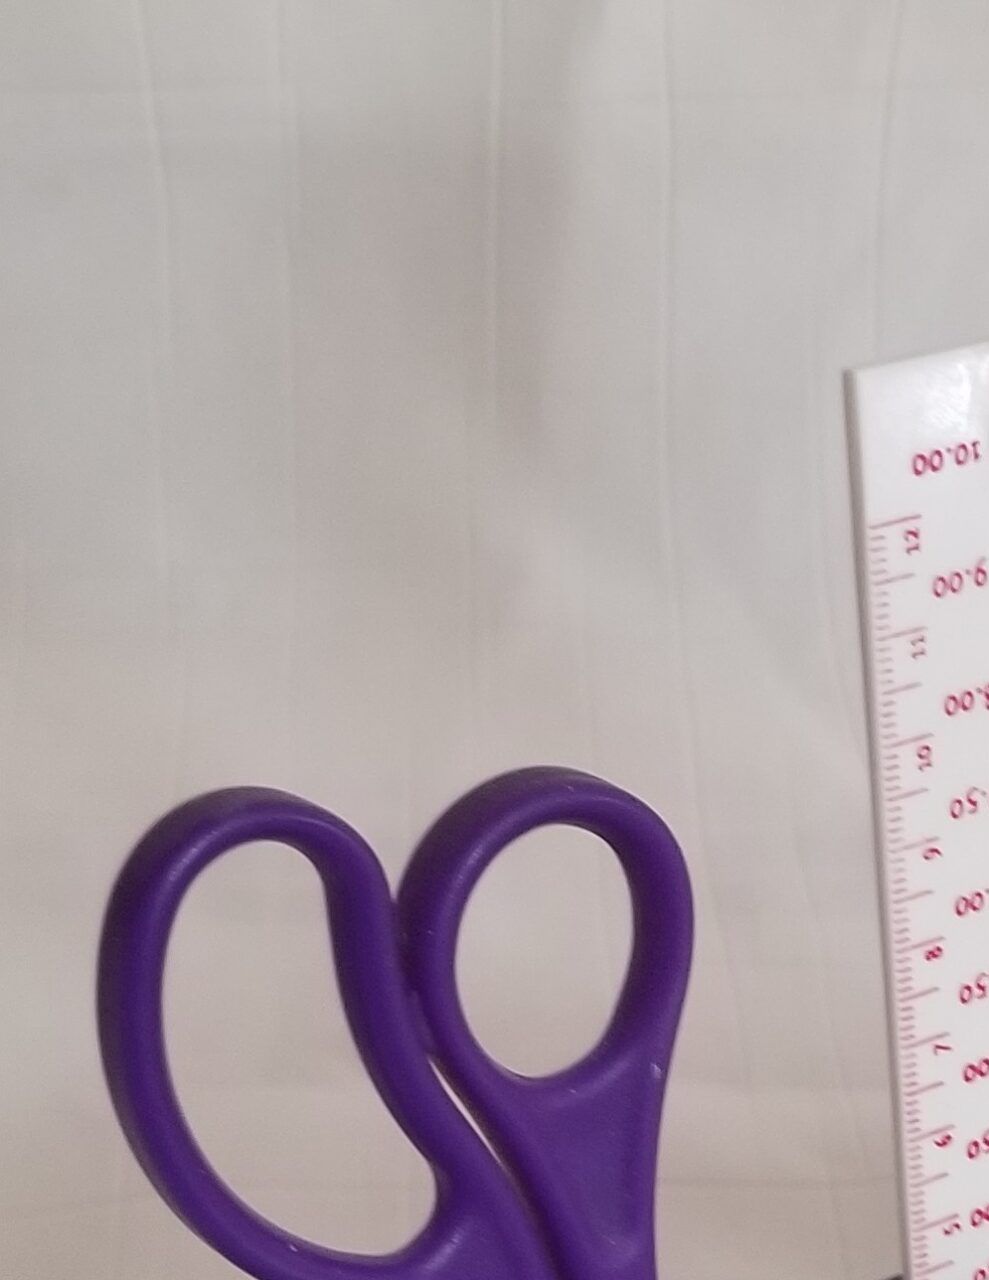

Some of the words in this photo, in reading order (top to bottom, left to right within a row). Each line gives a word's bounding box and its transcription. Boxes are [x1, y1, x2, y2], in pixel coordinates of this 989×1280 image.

[912, 440, 981, 476] 10.00
[904, 528, 920, 555] 12
[932, 556, 988, 598] 9.00
[910, 636, 927, 660] 11
[917, 745, 932, 771] 10
